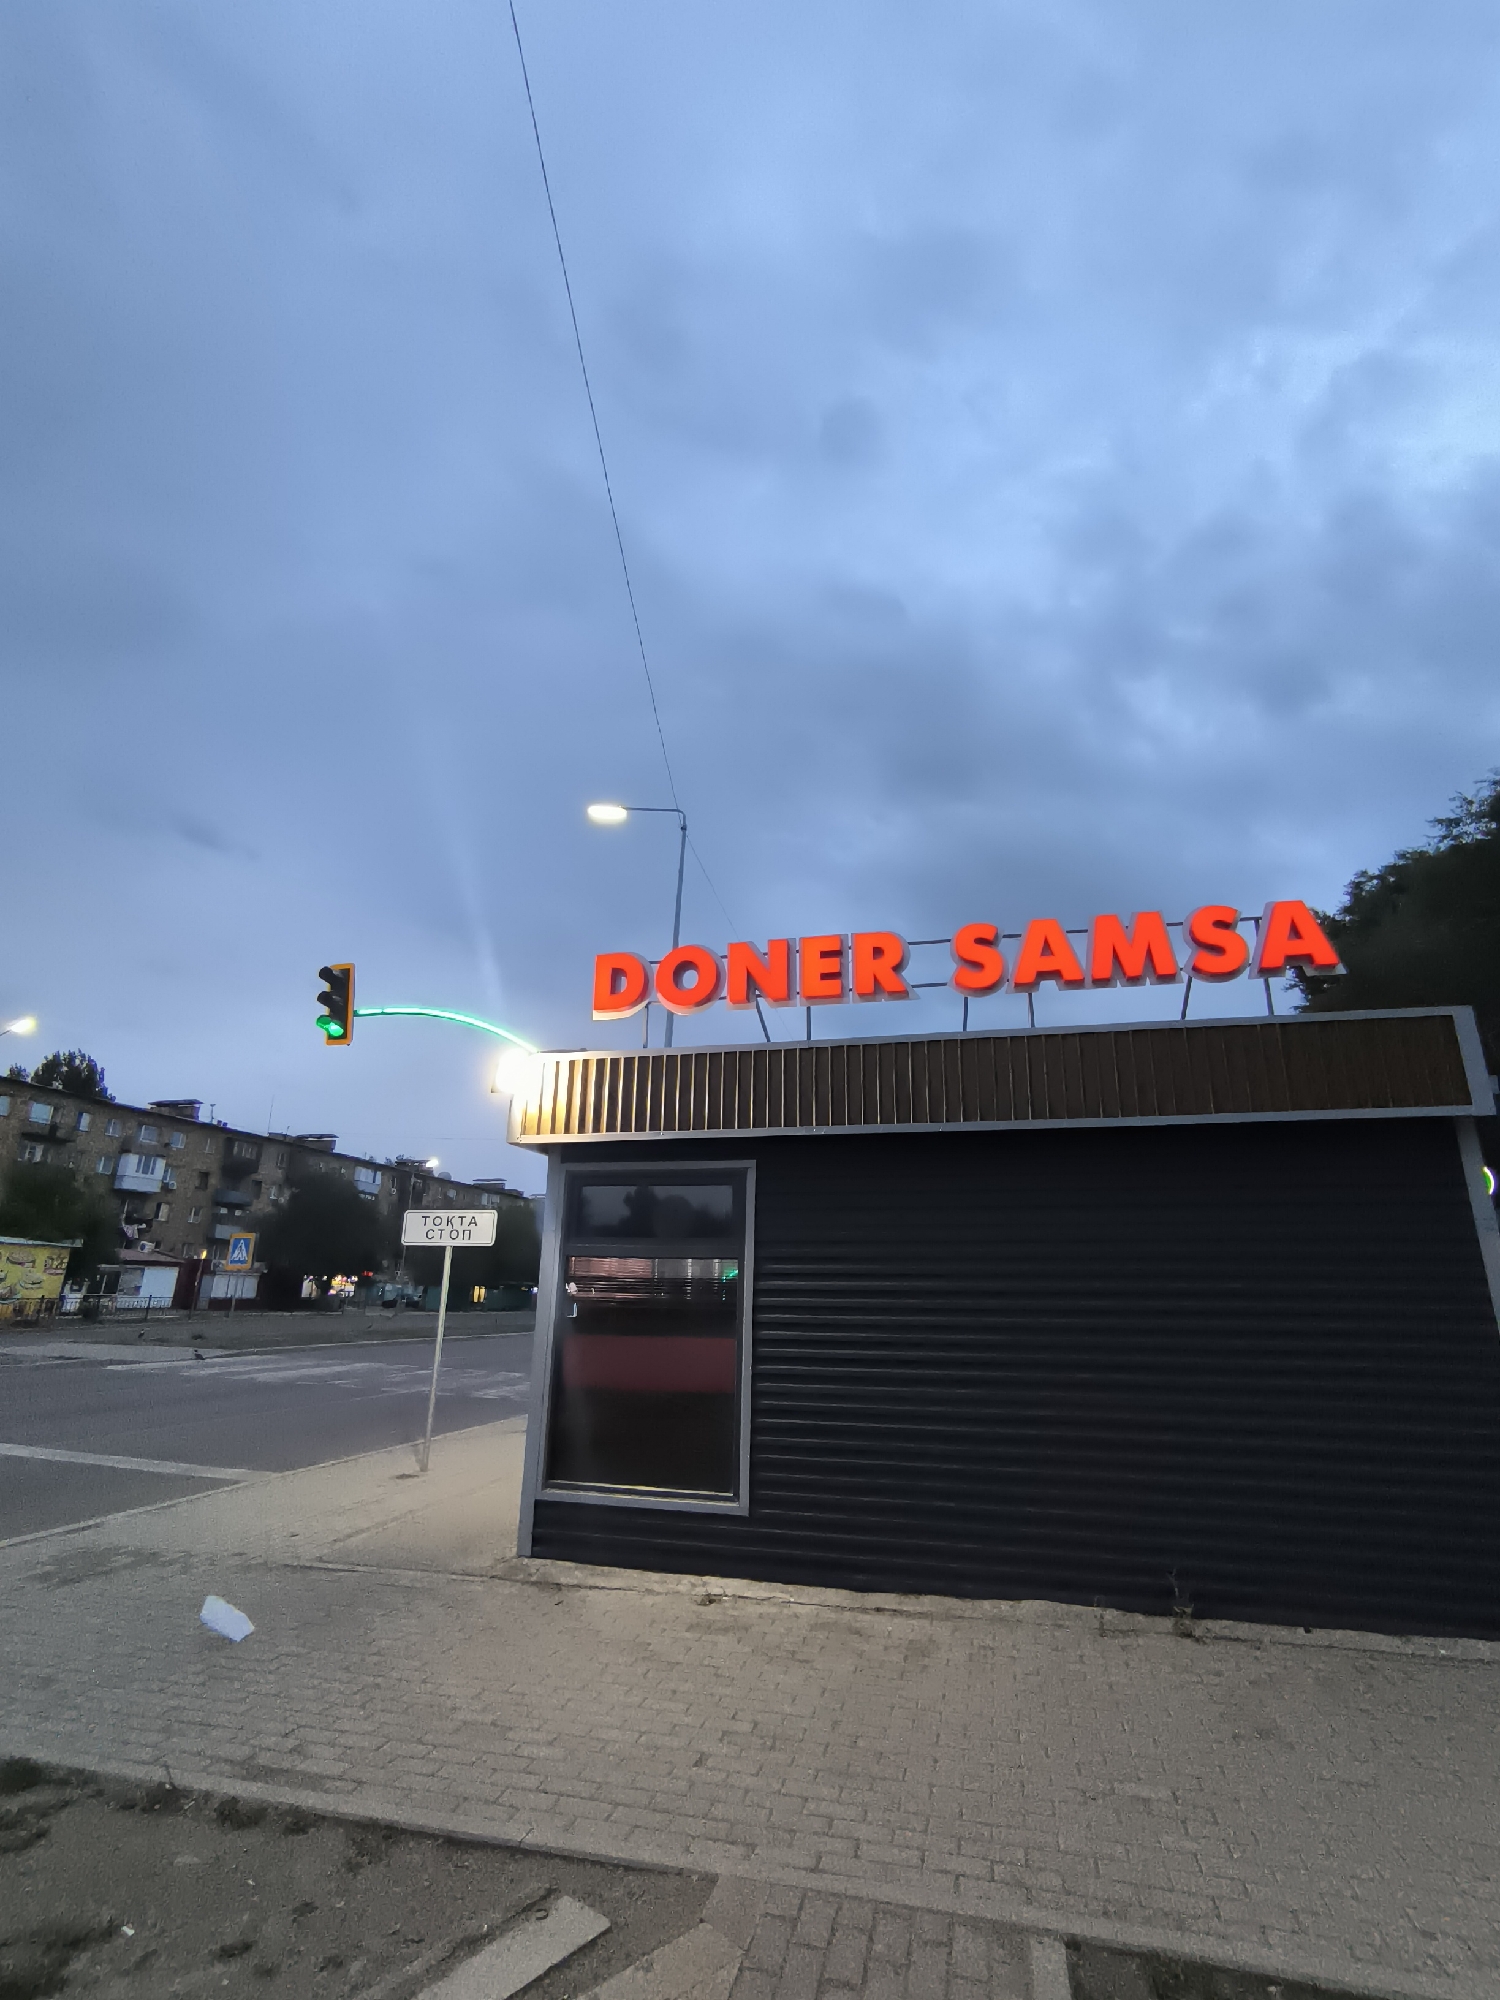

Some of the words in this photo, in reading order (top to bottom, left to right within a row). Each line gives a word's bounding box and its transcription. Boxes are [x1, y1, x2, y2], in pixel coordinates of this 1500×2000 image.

[593, 931, 914, 1015] DONER
[952, 900, 1341, 994] SAMSA
[421, 1215, 478, 1229] ТОҚТА
[425, 1229, 472, 1240] СТОП
